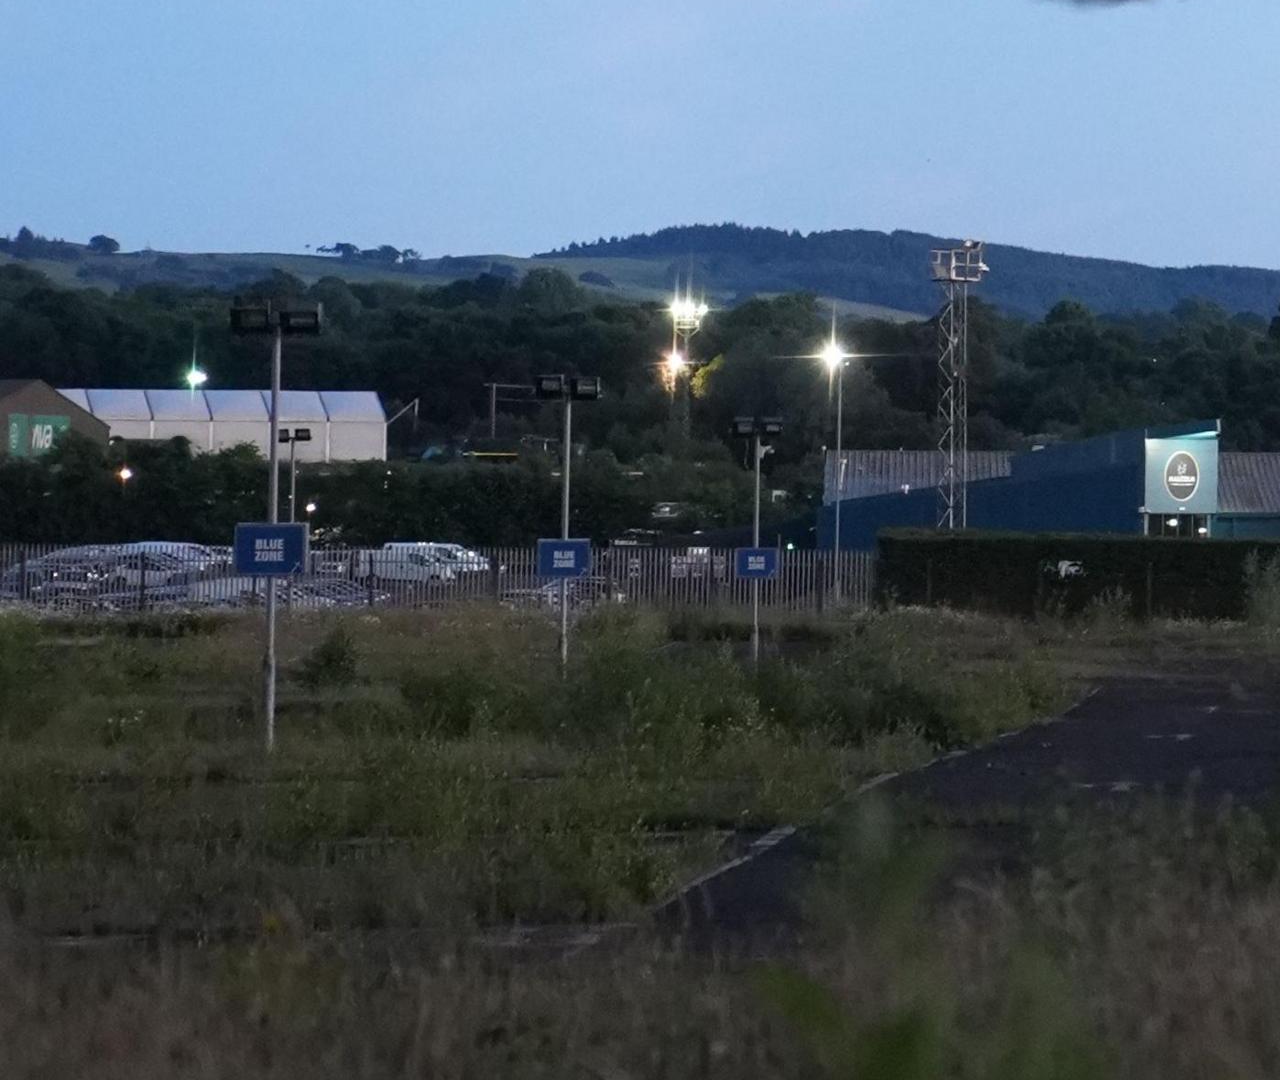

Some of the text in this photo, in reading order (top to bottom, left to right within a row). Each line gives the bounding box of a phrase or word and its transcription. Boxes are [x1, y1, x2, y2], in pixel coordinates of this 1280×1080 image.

[255, 538, 284, 550] BLUE
[254, 551, 284, 562] ZONE
[553, 550, 575, 559] BLUE
[552, 560, 575, 568] ZONE
